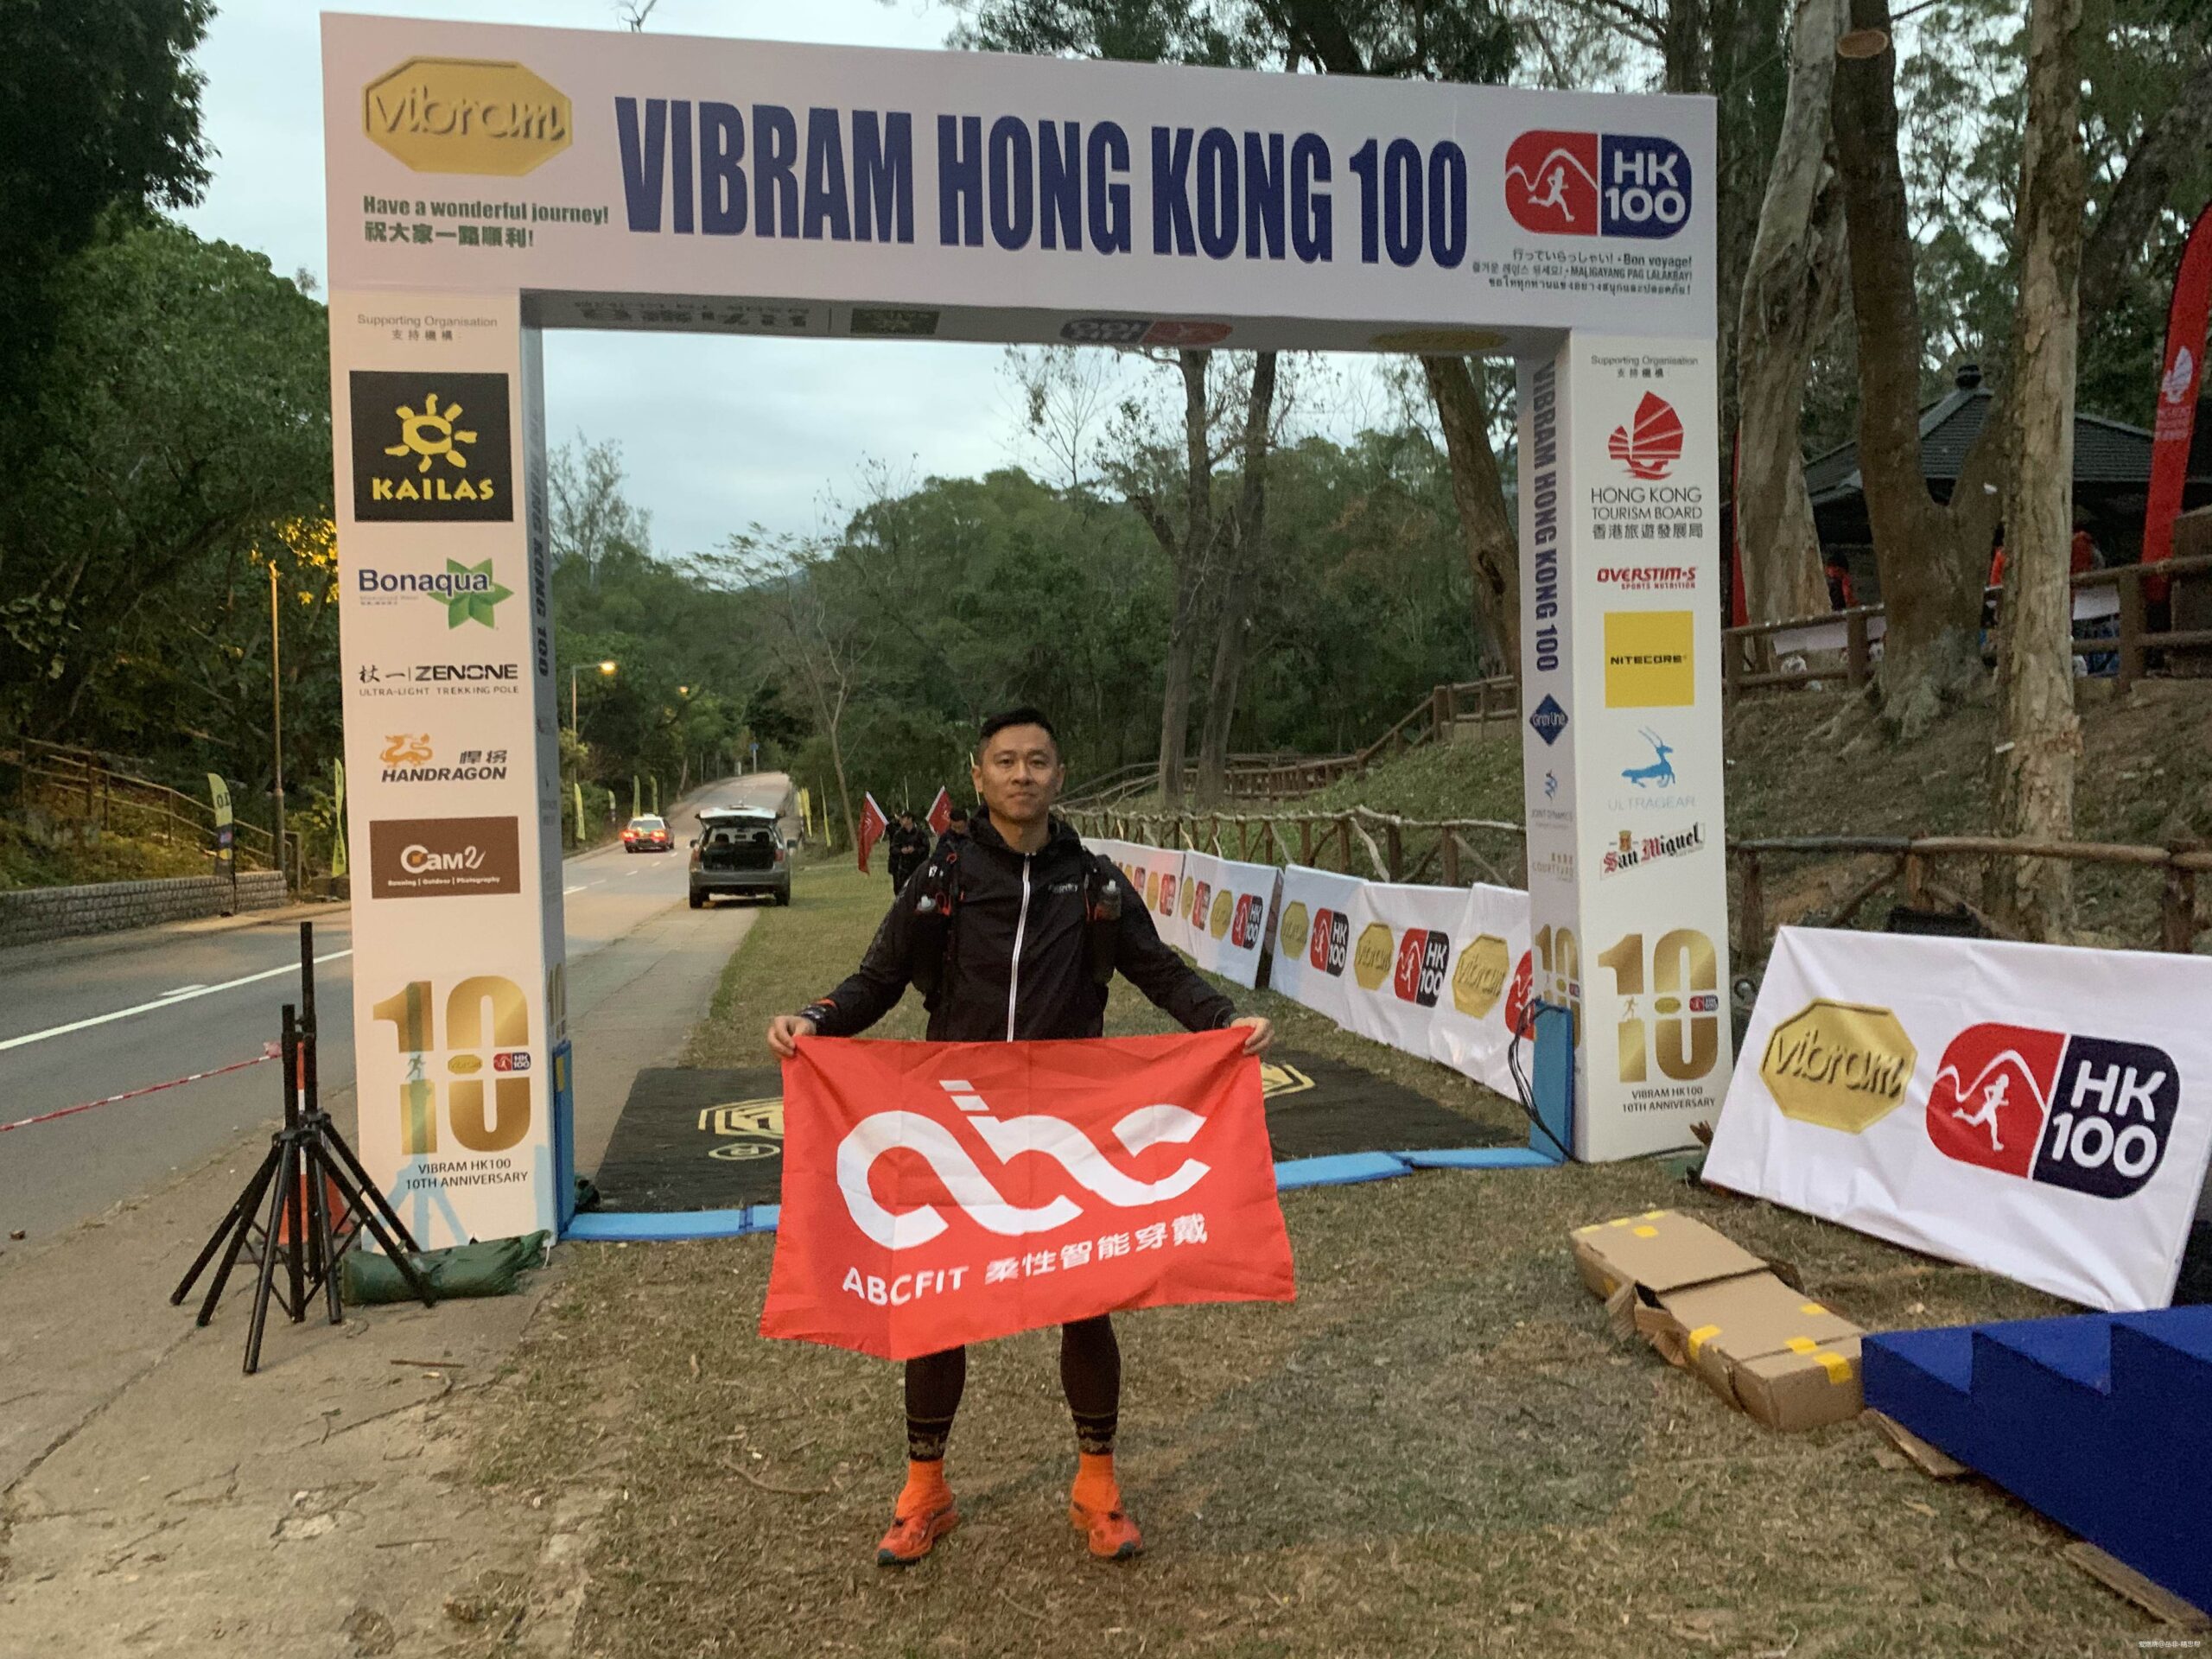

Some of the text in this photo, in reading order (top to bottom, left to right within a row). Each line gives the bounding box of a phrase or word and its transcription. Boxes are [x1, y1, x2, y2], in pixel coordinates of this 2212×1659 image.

[1613, 149, 1679, 188] HK
[614, 97, 1468, 270] VIBRAM HONG KONG 100
[364, 195, 608, 226] Have a wonderful journey!
[1605, 187, 1687, 224] 100
[1570, 267, 1625, 279] MALIGAYANG
[1624, 253, 1692, 269] Bon voyage!
[358, 314, 498, 328] Supporting Organisation
[1591, 355, 1699, 366] Supporting Organisation
[372, 477, 494, 501] KAILAS
[1591, 486, 1702, 504] HONG KONG
[1534, 360, 1559, 671] VIBRAM HONG KONG 100
[1592, 506, 1702, 520] TOURISM BOARD
[359, 569, 489, 597] Bonaqua
[1610, 655, 1682, 664] NITECORE
[415, 664, 518, 681] ZENONE
[359, 685, 518, 696] ULTRA-LIGHT TREKKING POLE
[381, 766, 507, 783] HANDRAGON
[1608, 796, 1696, 811] ULTRAGEAR
[1604, 822, 1704, 874] San Miguel
[1332, 921, 1348, 945] HK
[1329, 944, 1346, 968] 100
[1427, 942, 1447, 969] HK
[1420, 968, 1444, 995] 100
[1598, 929, 1719, 1083] 10
[372, 976, 531, 1156] 10
[1631, 1086, 1703, 1099] VIBRAM HK100
[2070, 1059, 2167, 1122] HK
[1623, 1097, 1715, 1113] 10TH ANNIVERSARY
[2053, 1114, 2158, 1179] 100
[418, 1158, 511, 1174] VIBRAM HK100
[405, 1171, 529, 1190] 10TH ANNIVERSARY
[984, 1213, 1209, 1286] 柔性智能穿戴
[842, 1267, 969, 1306] ABCFIT
